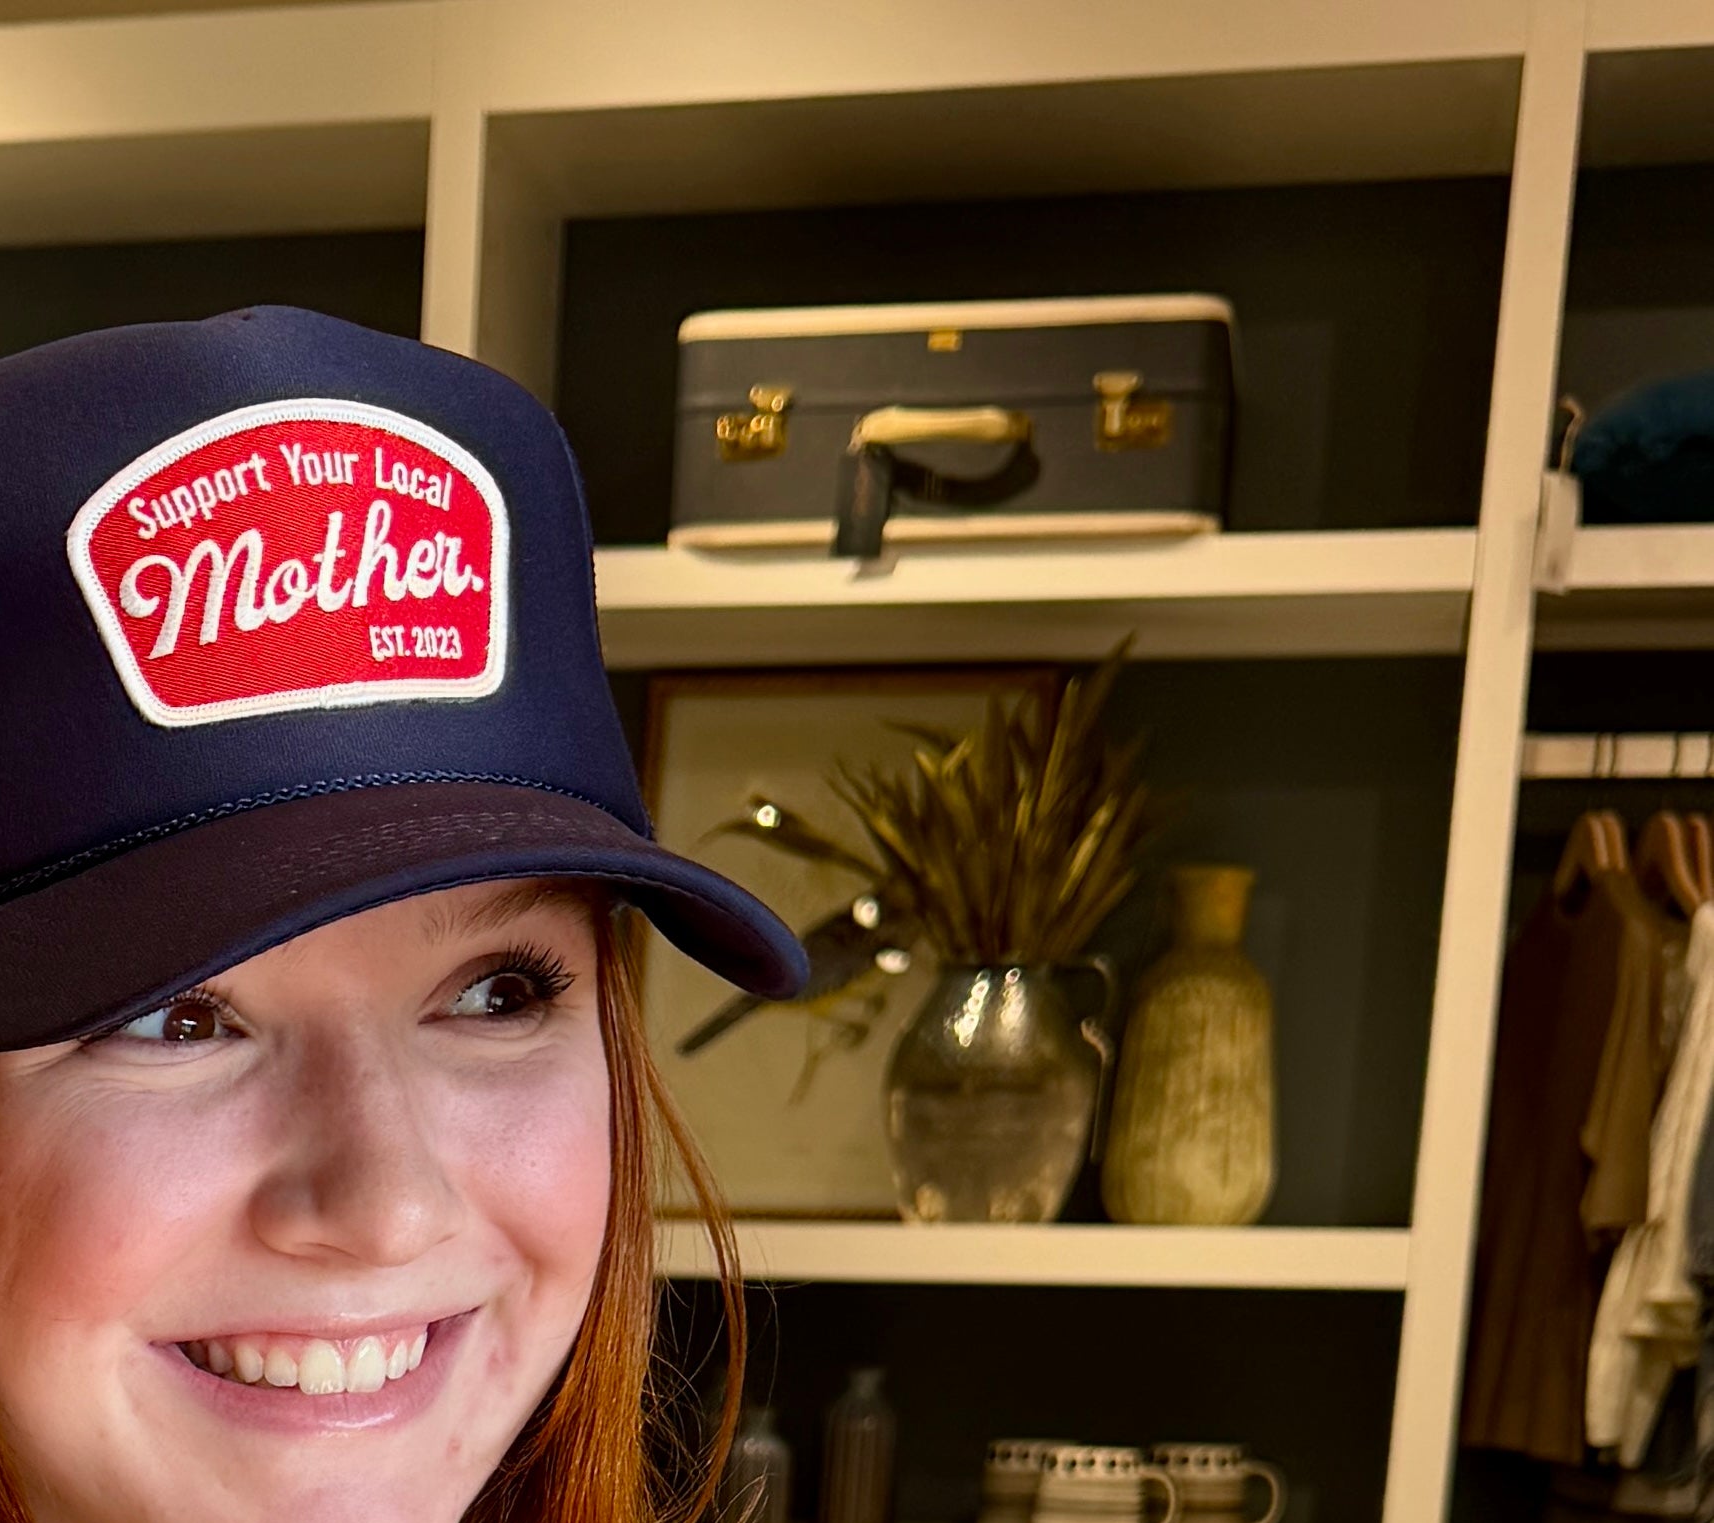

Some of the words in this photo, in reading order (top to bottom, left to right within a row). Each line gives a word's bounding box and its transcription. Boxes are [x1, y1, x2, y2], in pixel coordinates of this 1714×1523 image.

[127, 451, 272, 539] Support
[279, 442, 360, 486] Your
[375, 446, 453, 511] Local
[369, 624, 410, 661] EST.
[411, 626, 463, 659] 2023
